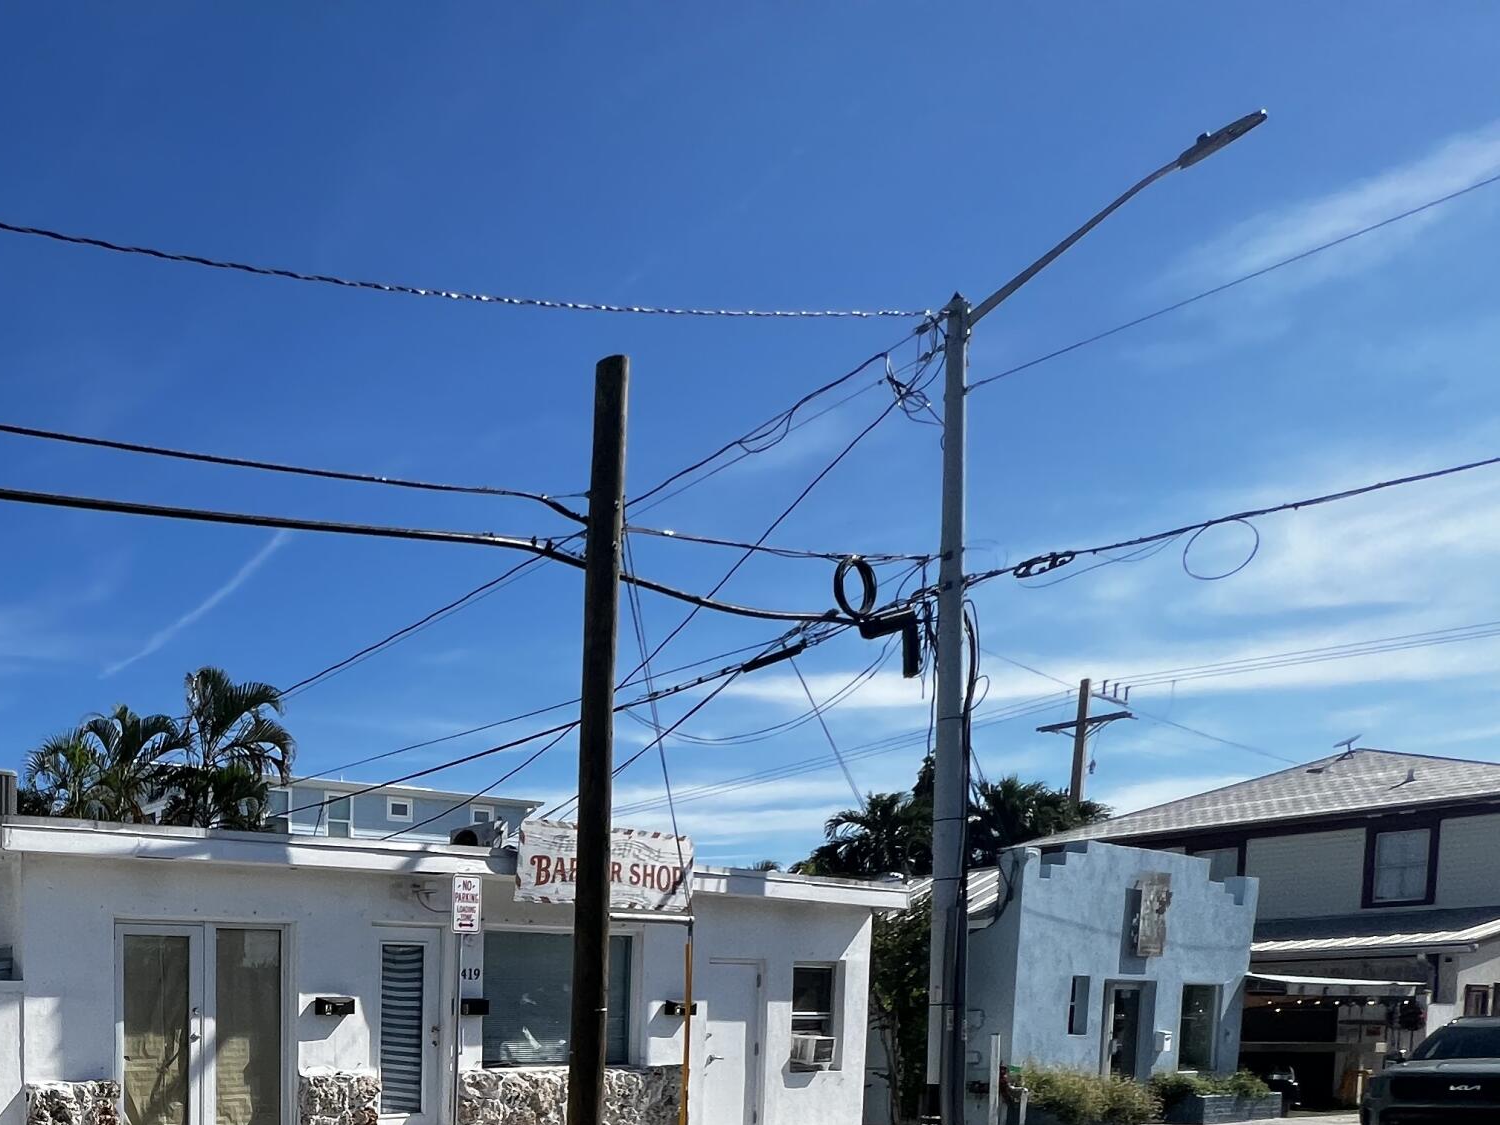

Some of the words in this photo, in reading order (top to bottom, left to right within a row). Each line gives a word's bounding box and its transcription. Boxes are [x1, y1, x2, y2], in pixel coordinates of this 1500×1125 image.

[530, 854, 622, 887] BARR
[629, 863, 684, 895] SHOP
[462, 880, 472, 891] NO
[455, 892, 479, 903] PARKING
[461, 968, 480, 981] 419
